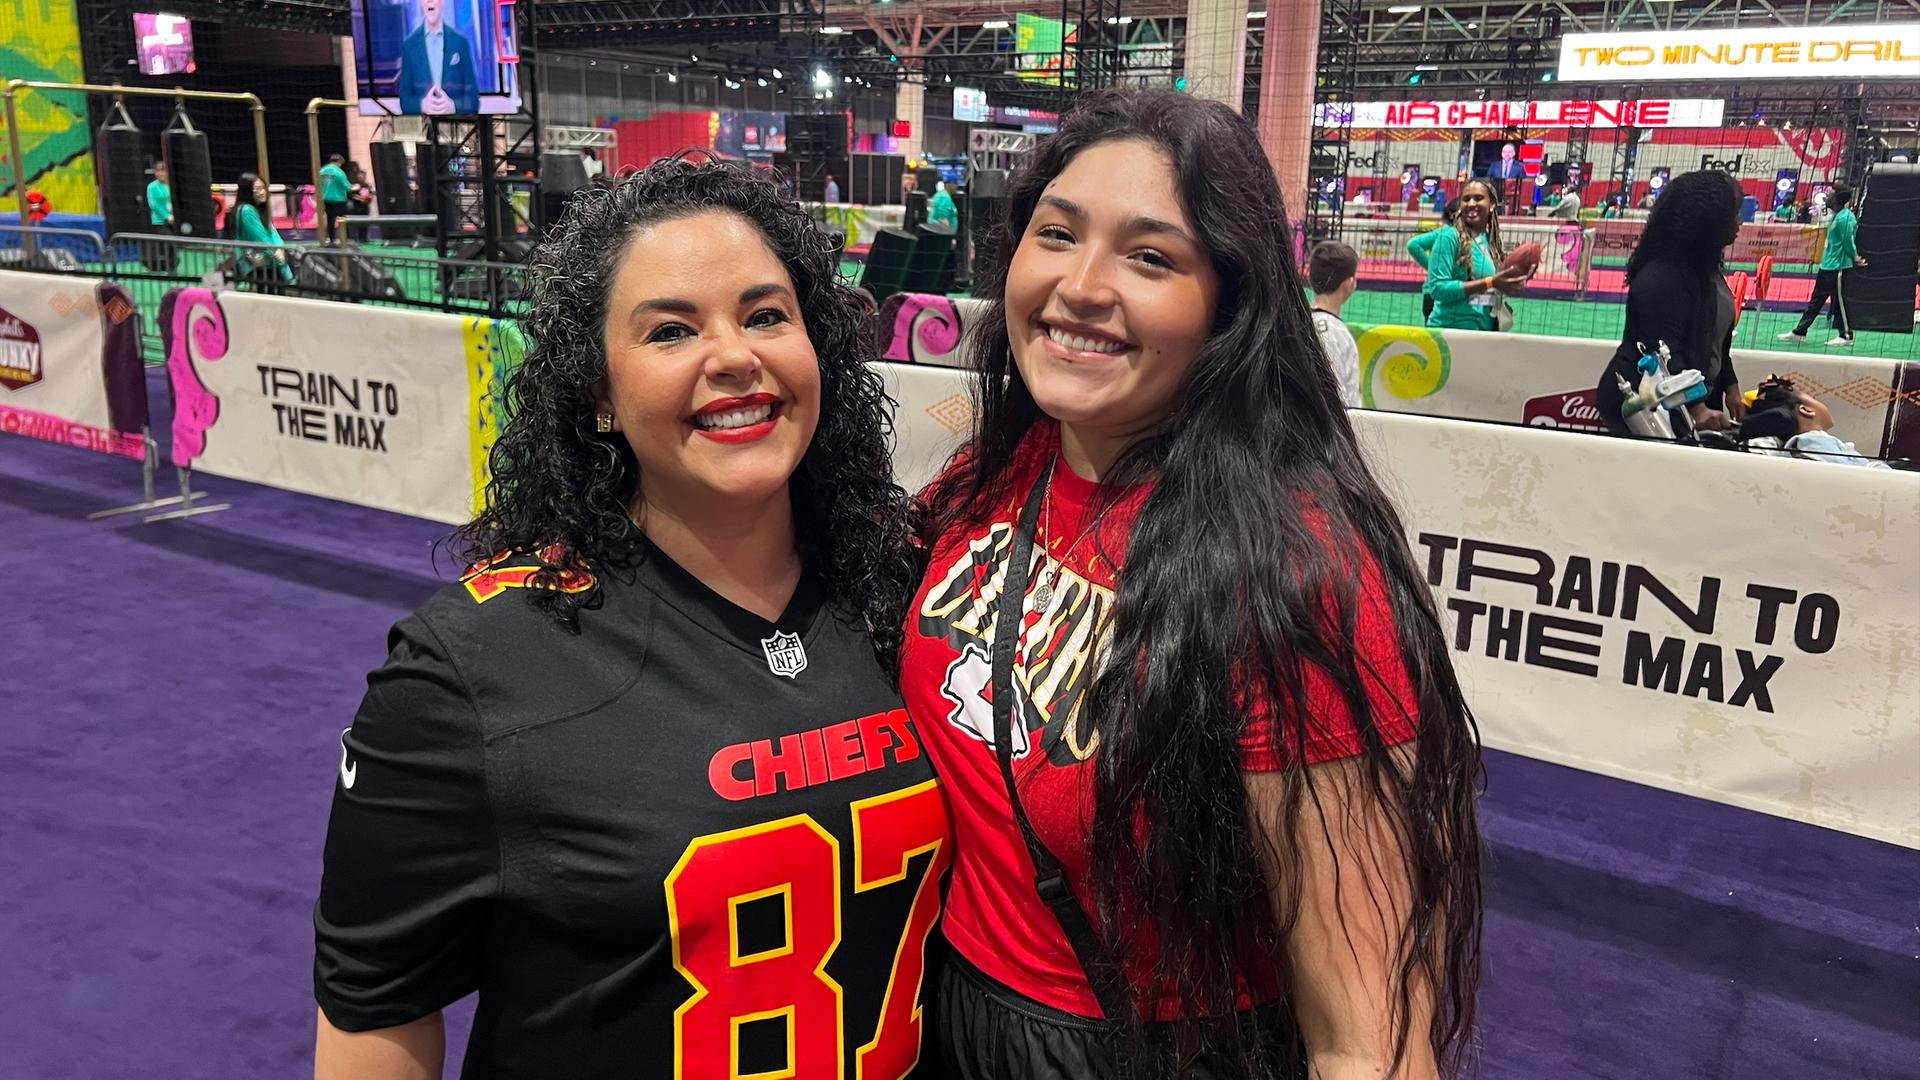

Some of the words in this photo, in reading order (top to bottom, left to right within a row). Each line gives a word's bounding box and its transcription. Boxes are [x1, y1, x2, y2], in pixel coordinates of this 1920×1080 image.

[1573, 45, 1655, 66] TWO
[1662, 41, 1801, 65] MINUTE
[1385, 101, 1440, 125] AIR
[1449, 101, 1670, 125] CHALLENGE
[1700, 153, 1771, 173] FedEx
[256, 364, 361, 411] TRAIN
[366, 379, 399, 416] TO
[271, 403, 328, 442] THE
[333, 413, 388, 452] MAX
[1418, 531, 1721, 635] TRAIN
[1745, 583, 1841, 654] TO
[773, 649, 802, 670] NFL
[1447, 597, 1604, 678] THE
[1622, 630, 1785, 714] MAX
[708, 708, 920, 800] CHIEFS
[664, 778, 951, 1080] 87
